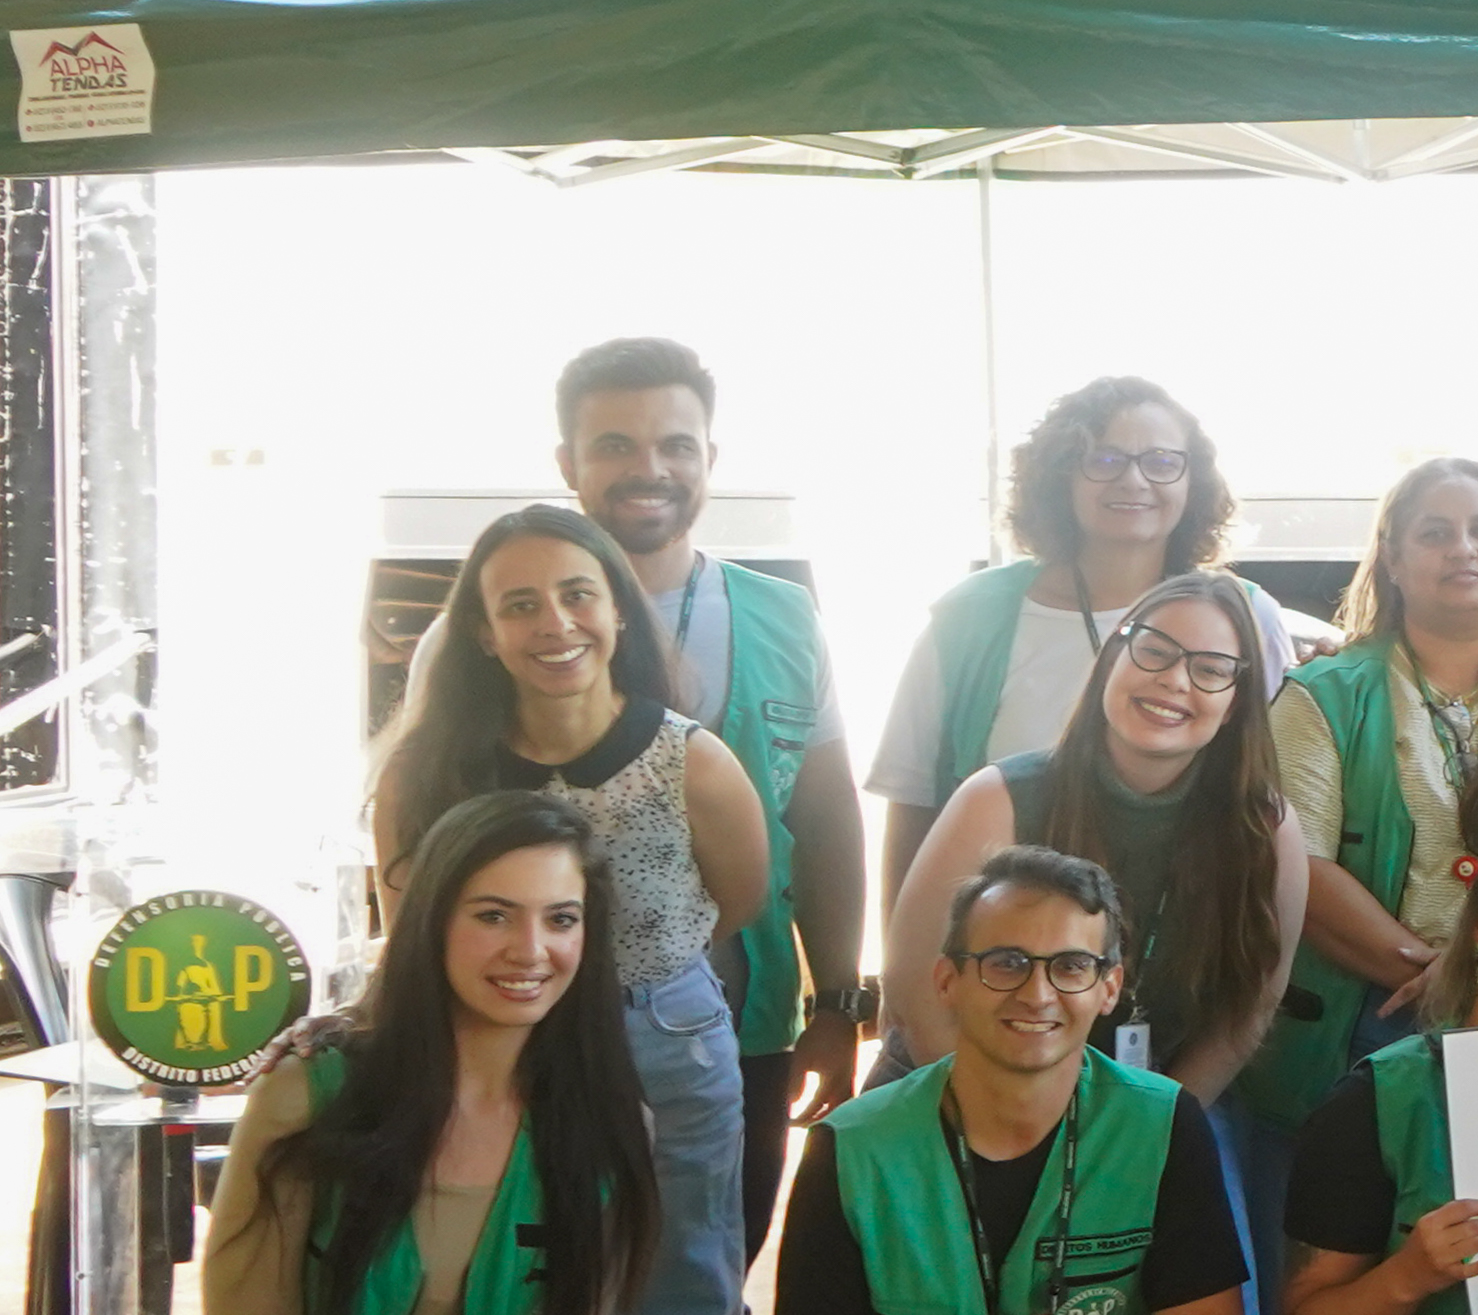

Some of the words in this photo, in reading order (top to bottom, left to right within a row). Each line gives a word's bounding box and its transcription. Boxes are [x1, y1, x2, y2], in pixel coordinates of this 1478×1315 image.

[51, 55, 127, 77] ALPHA
[50, 73, 128, 93] TENDAS
[94, 892, 224, 968] DEFENSORIA
[121, 1046, 198, 1083] DISTRITO
